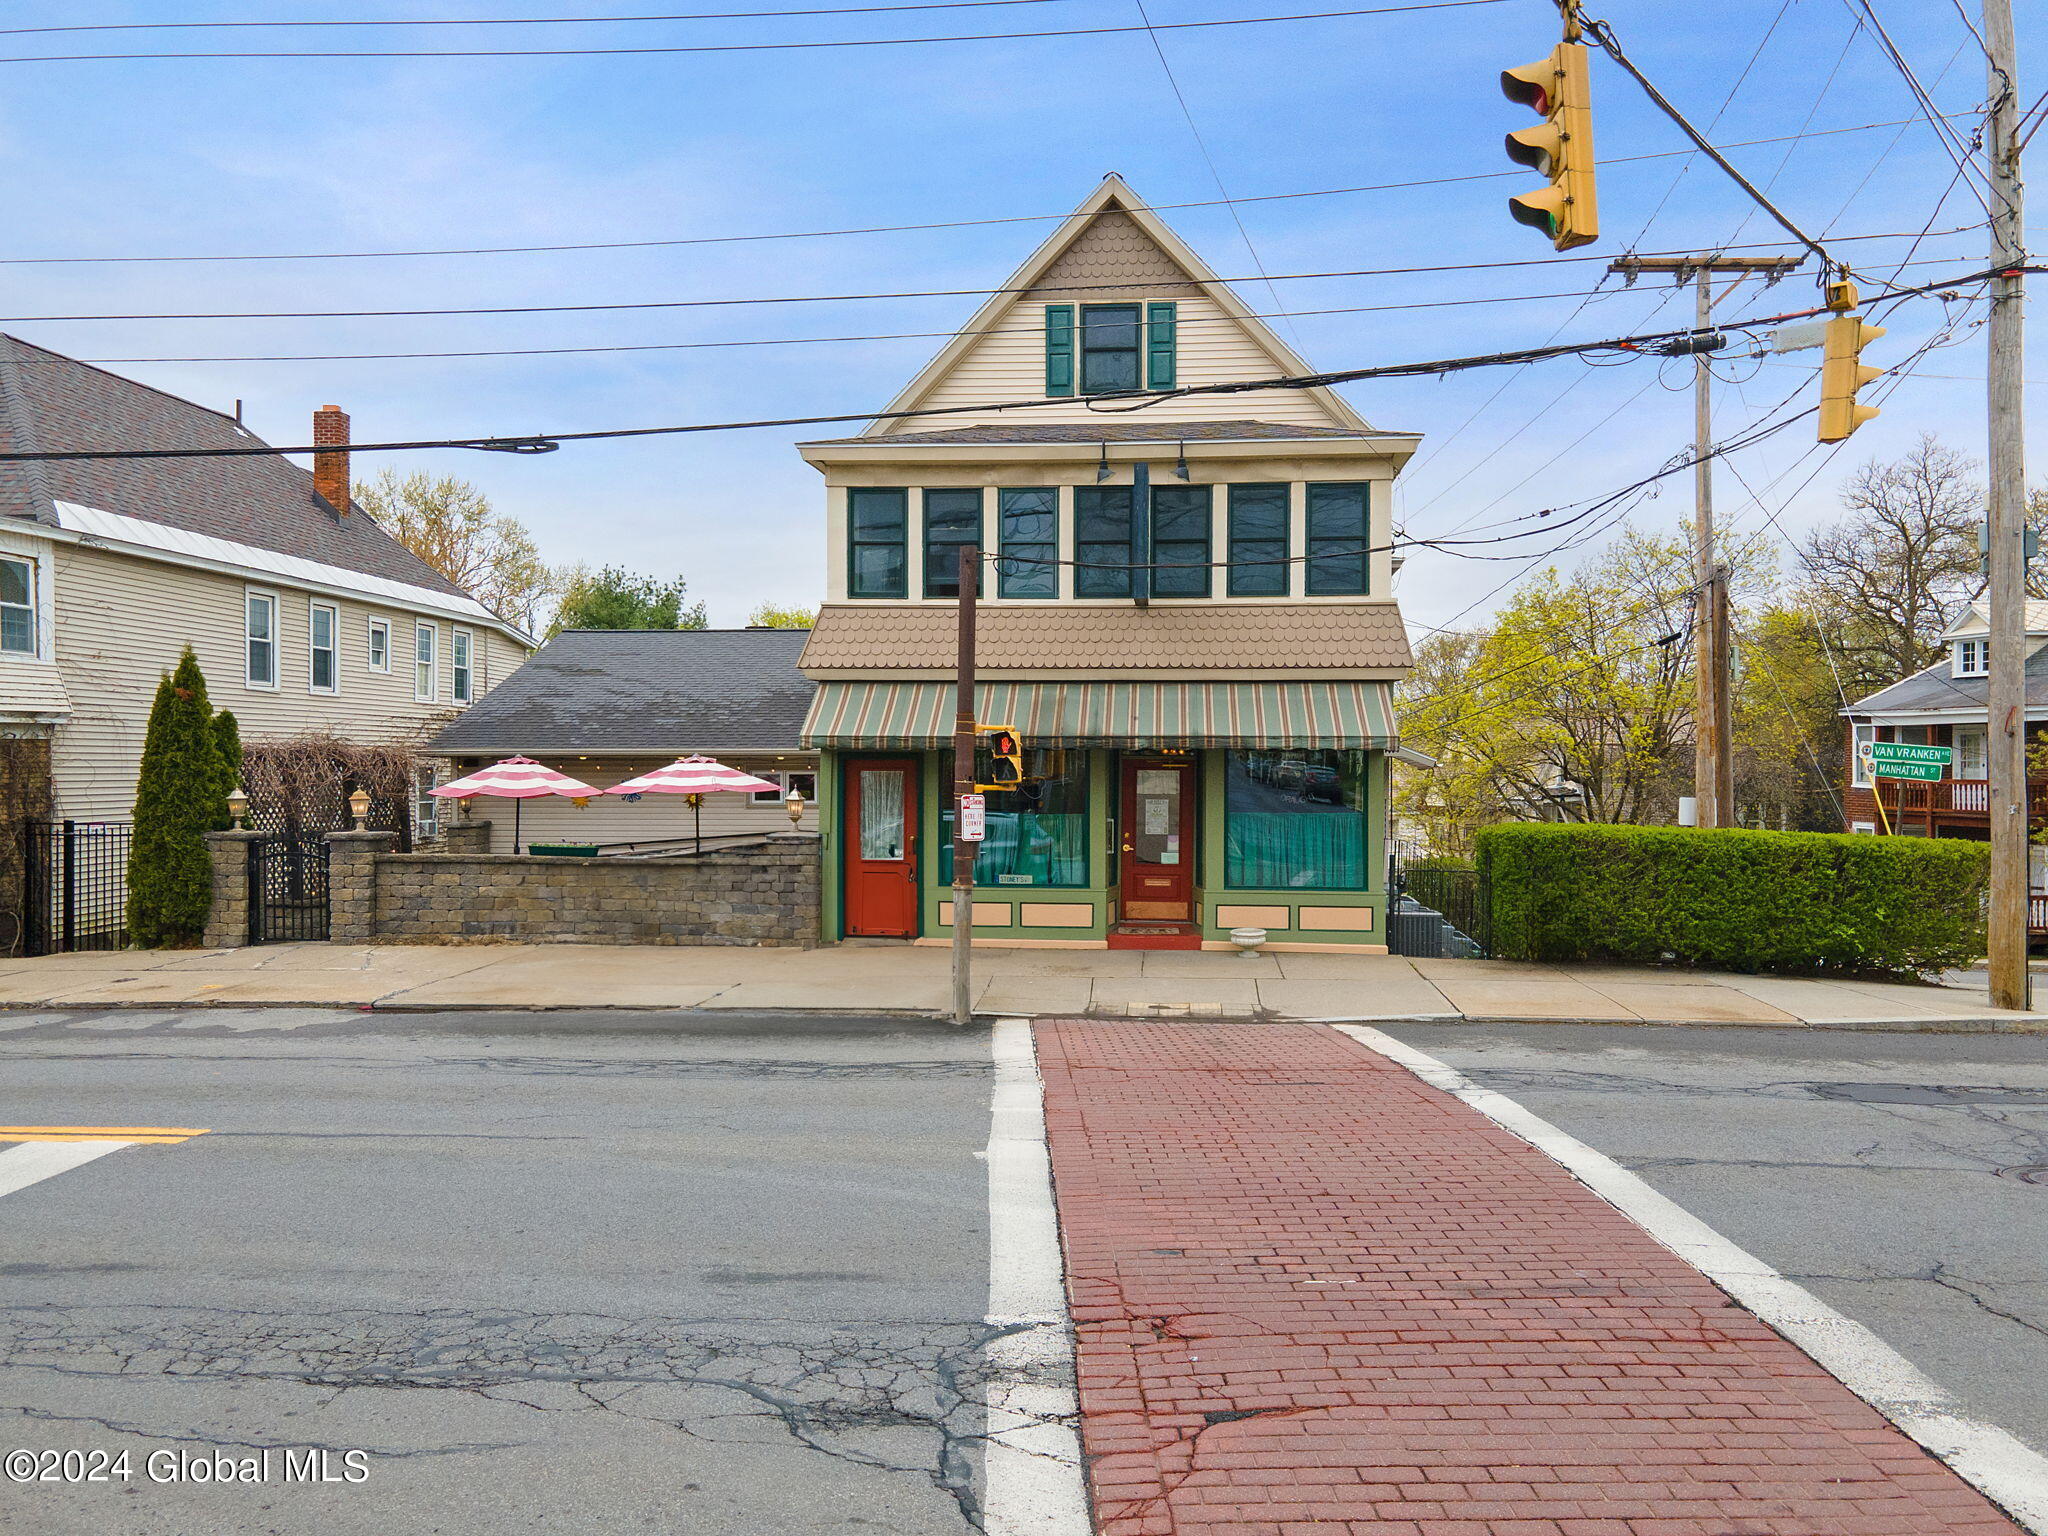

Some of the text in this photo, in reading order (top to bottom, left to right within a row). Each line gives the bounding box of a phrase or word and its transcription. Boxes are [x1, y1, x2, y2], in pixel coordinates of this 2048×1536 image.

[1874, 746, 1894, 757] VAN
[1896, 747, 1941, 760] VRANKEN
[1878, 764, 1926, 777] MANHATTAN
